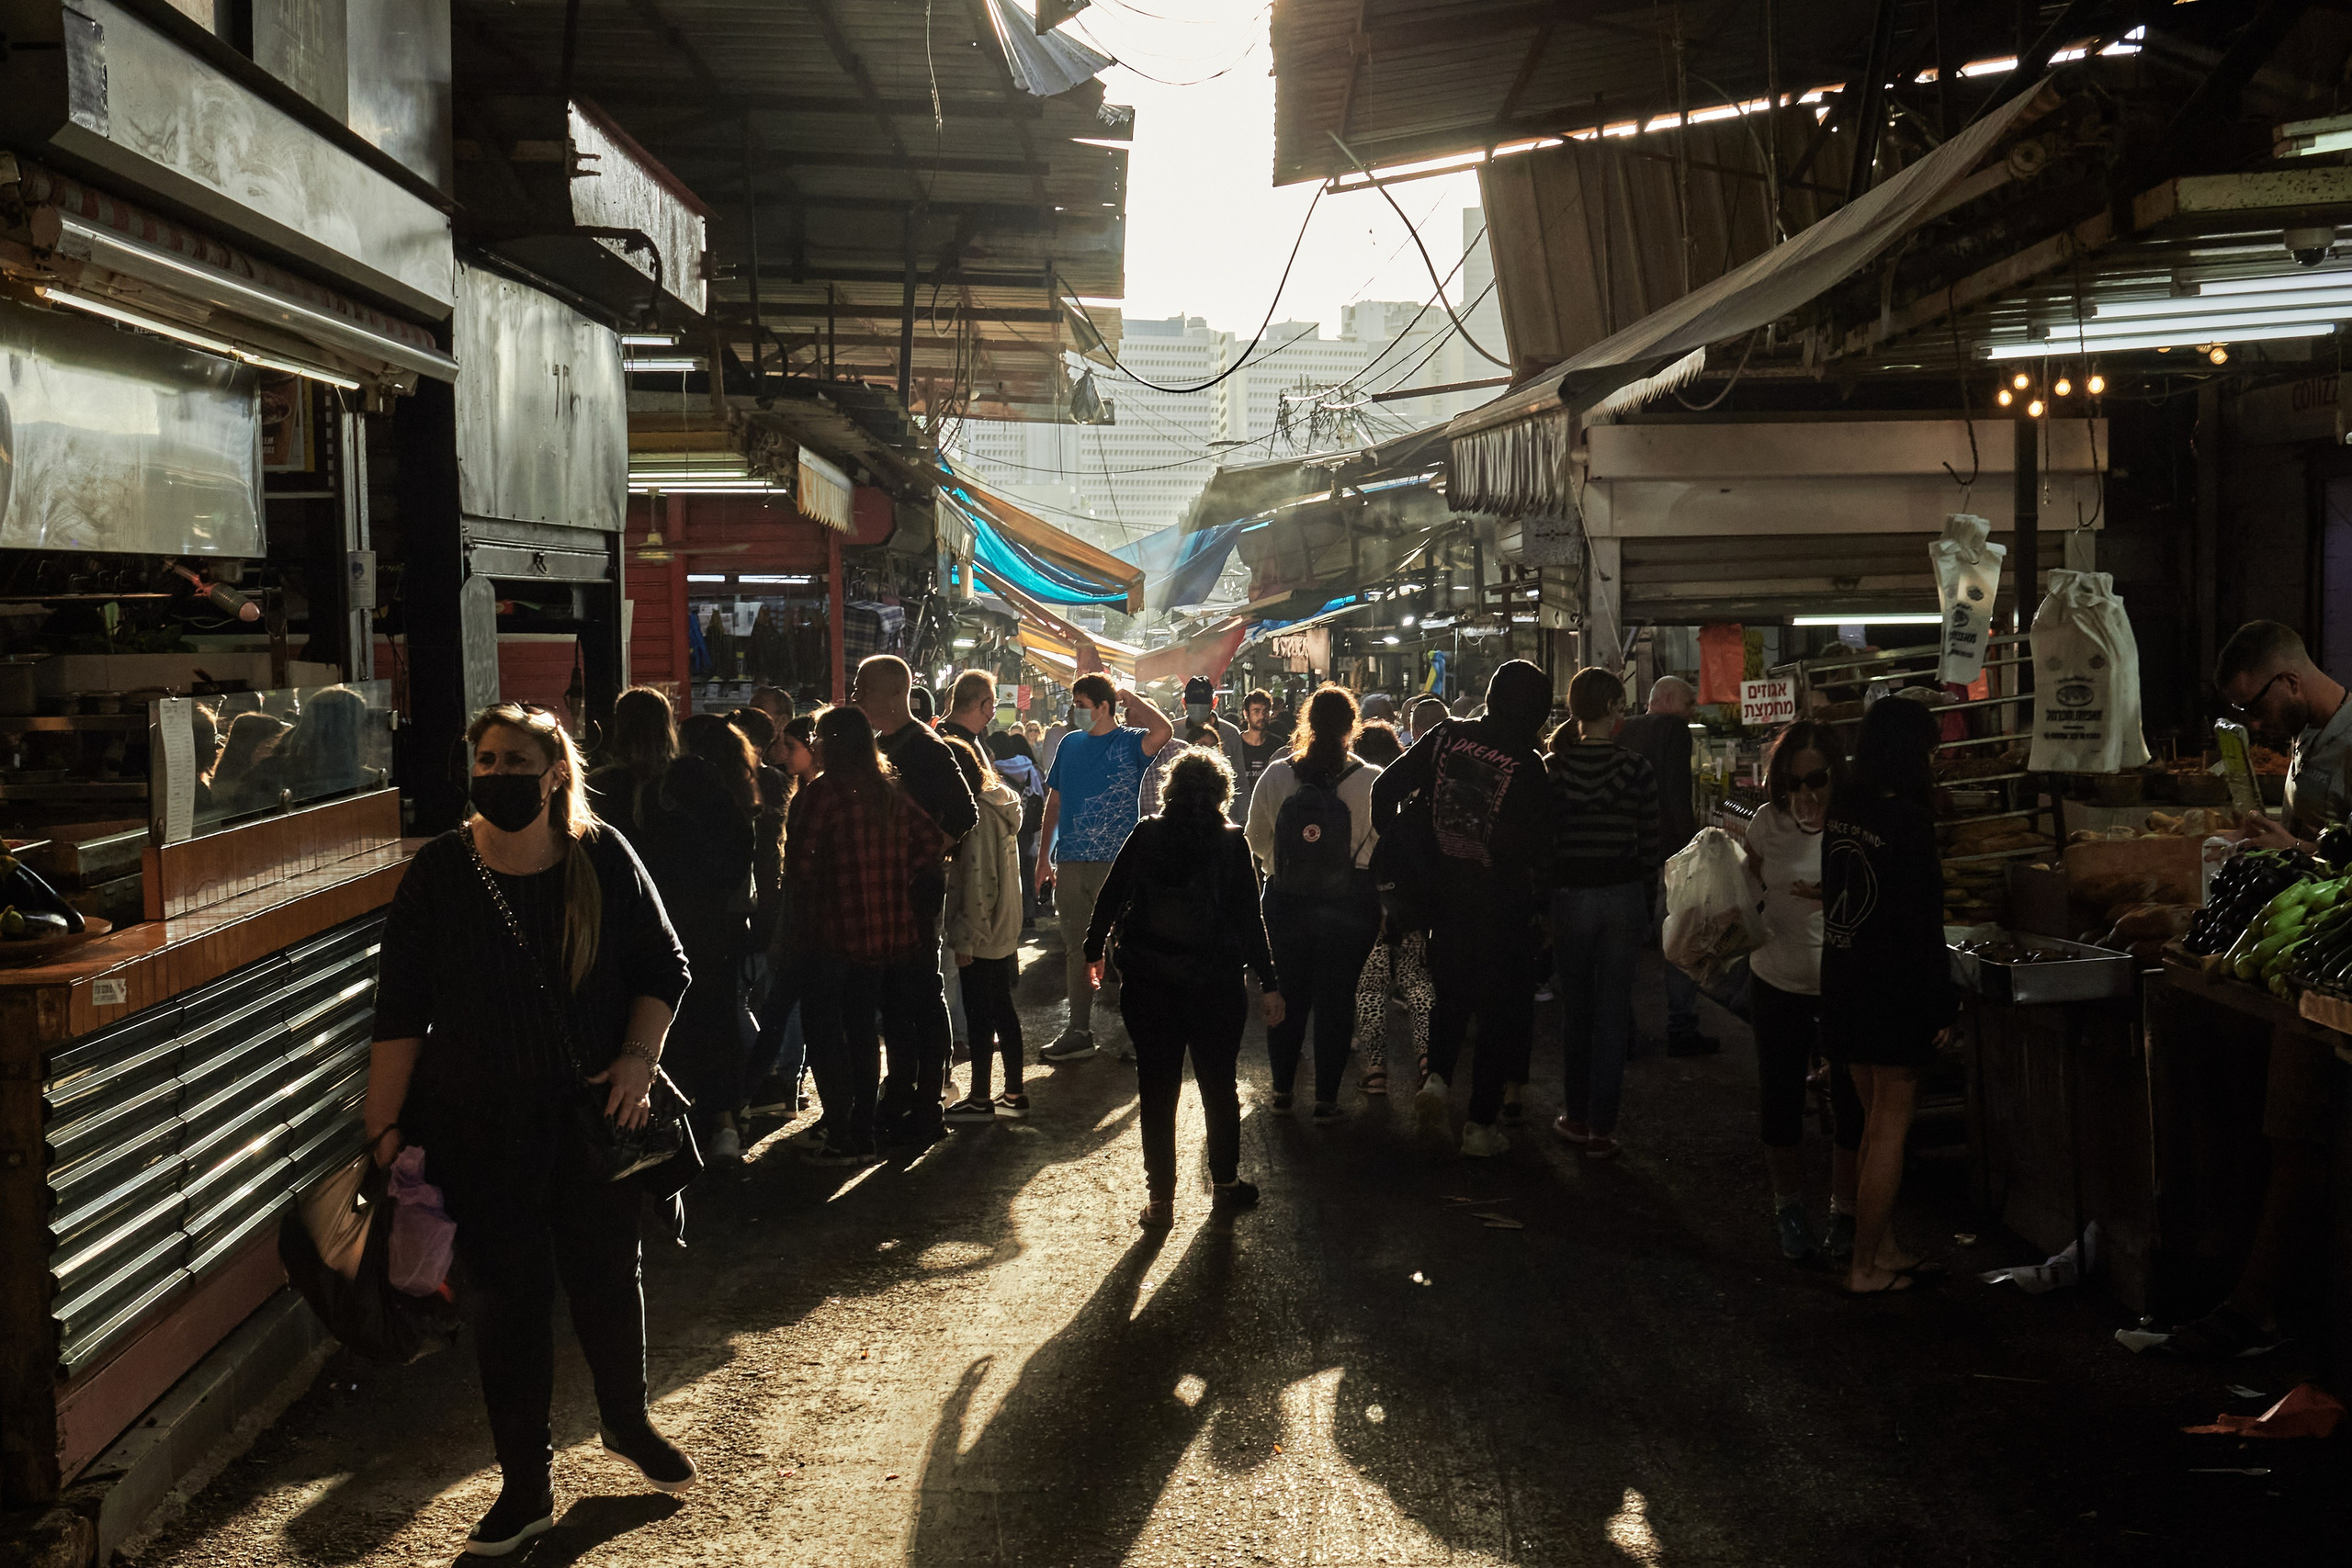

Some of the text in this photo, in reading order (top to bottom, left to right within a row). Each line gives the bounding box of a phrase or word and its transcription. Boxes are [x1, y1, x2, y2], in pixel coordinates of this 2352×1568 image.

[1747, 682, 1786, 699] אגוזים
[1744, 701, 1793, 718] מחמצת
[1452, 738, 1521, 774] DREAMS
